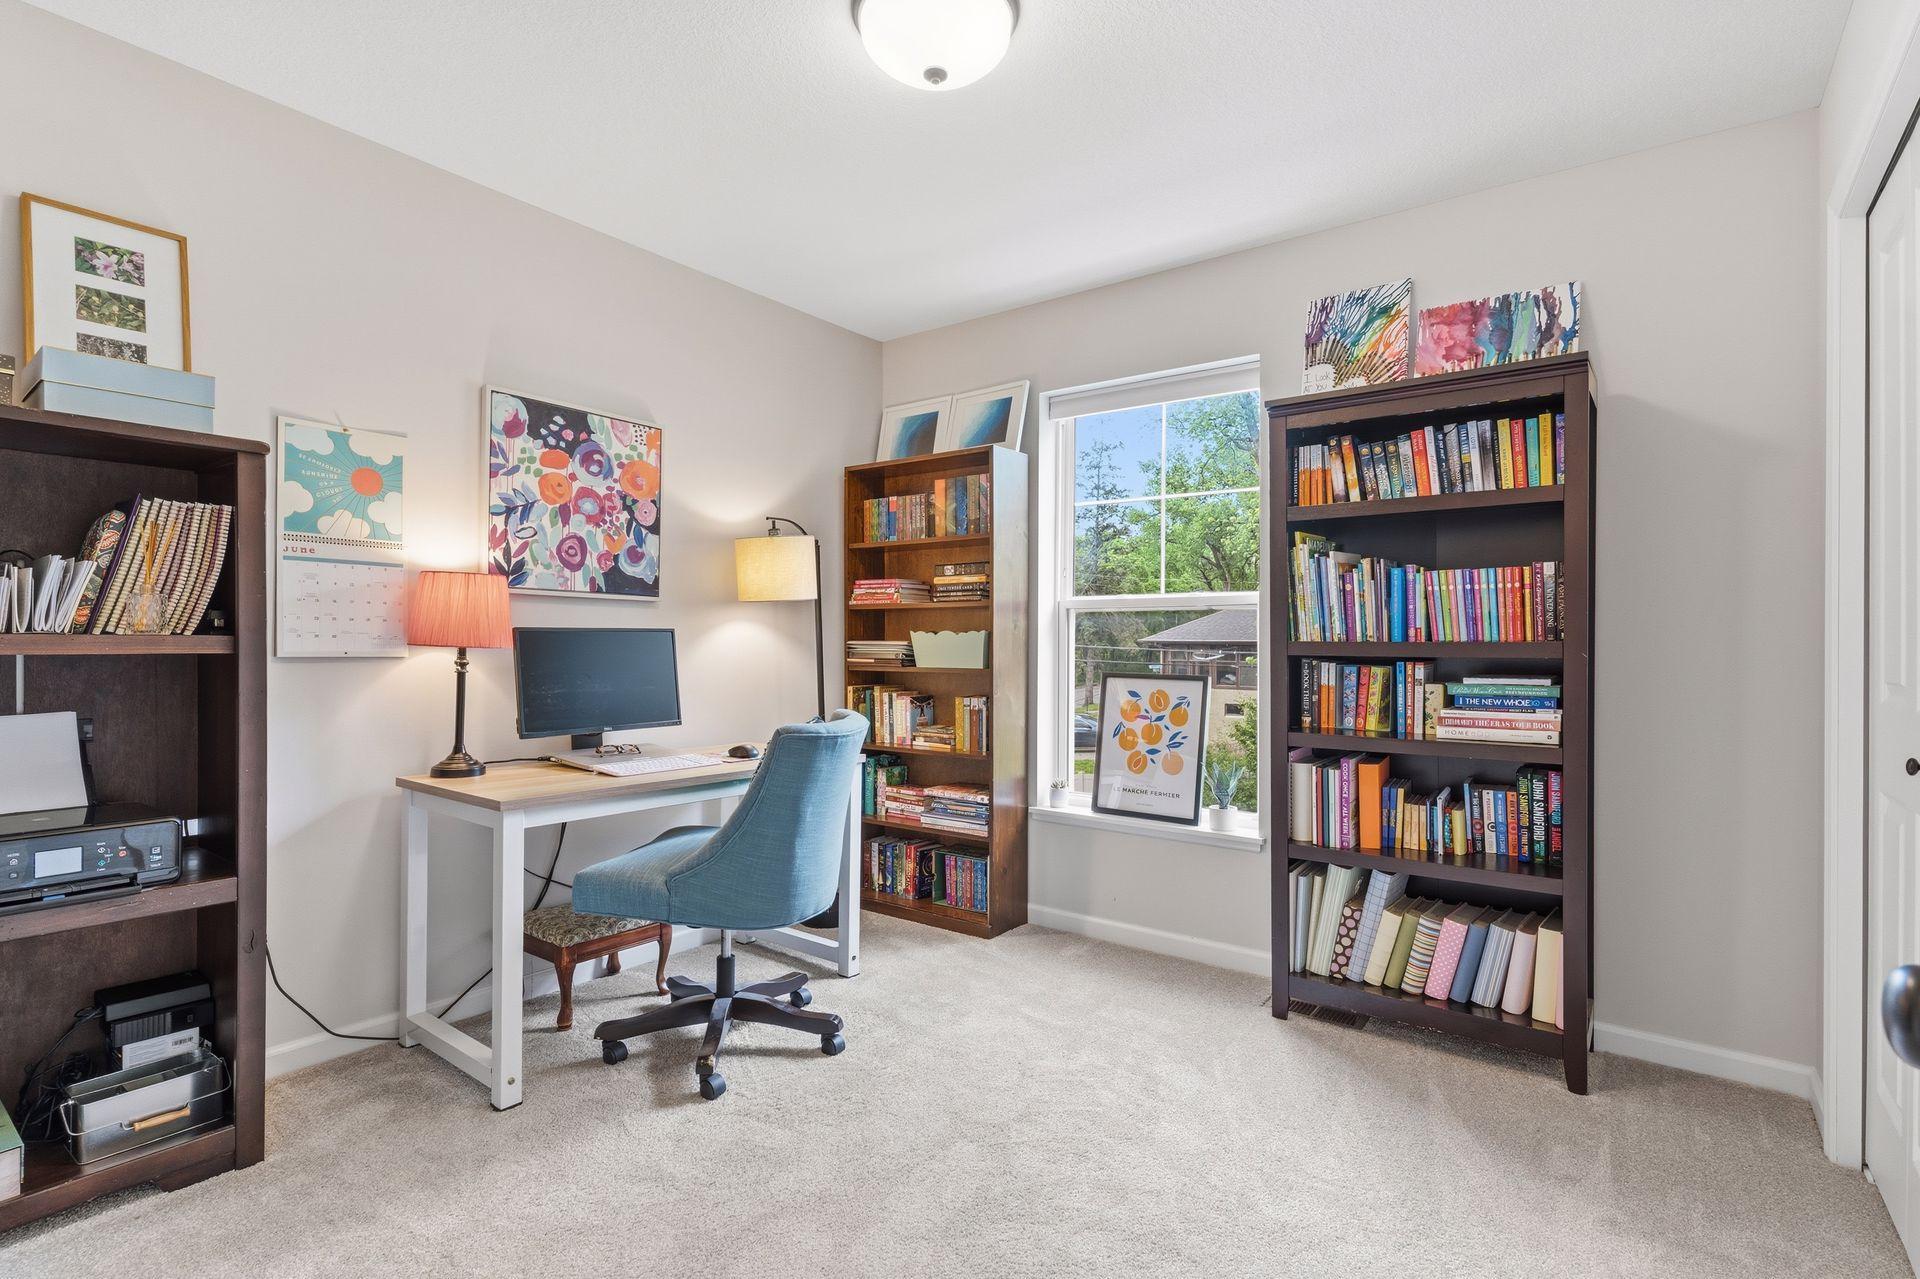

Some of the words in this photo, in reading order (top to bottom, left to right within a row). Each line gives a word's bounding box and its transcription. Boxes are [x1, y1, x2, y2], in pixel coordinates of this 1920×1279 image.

[1546, 612, 1554, 627] KING
[1465, 697, 1480, 705] THE
[1482, 698, 1502, 706] NEW
[1474, 719, 1490, 727] THE
[1490, 720, 1510, 728] ERAS
[1532, 721, 1555, 730] BOOK
[1519, 777, 1528, 794] JOHN
[1533, 779, 1544, 800] JOHN
[1551, 773, 1561, 790] JOHN
[1519, 794, 1529, 826] SANDFORD
[1551, 792, 1562, 824] SANDFORD
[1533, 801, 1545, 841] SANDFORD
[1552, 832, 1562, 852] ANGEL
